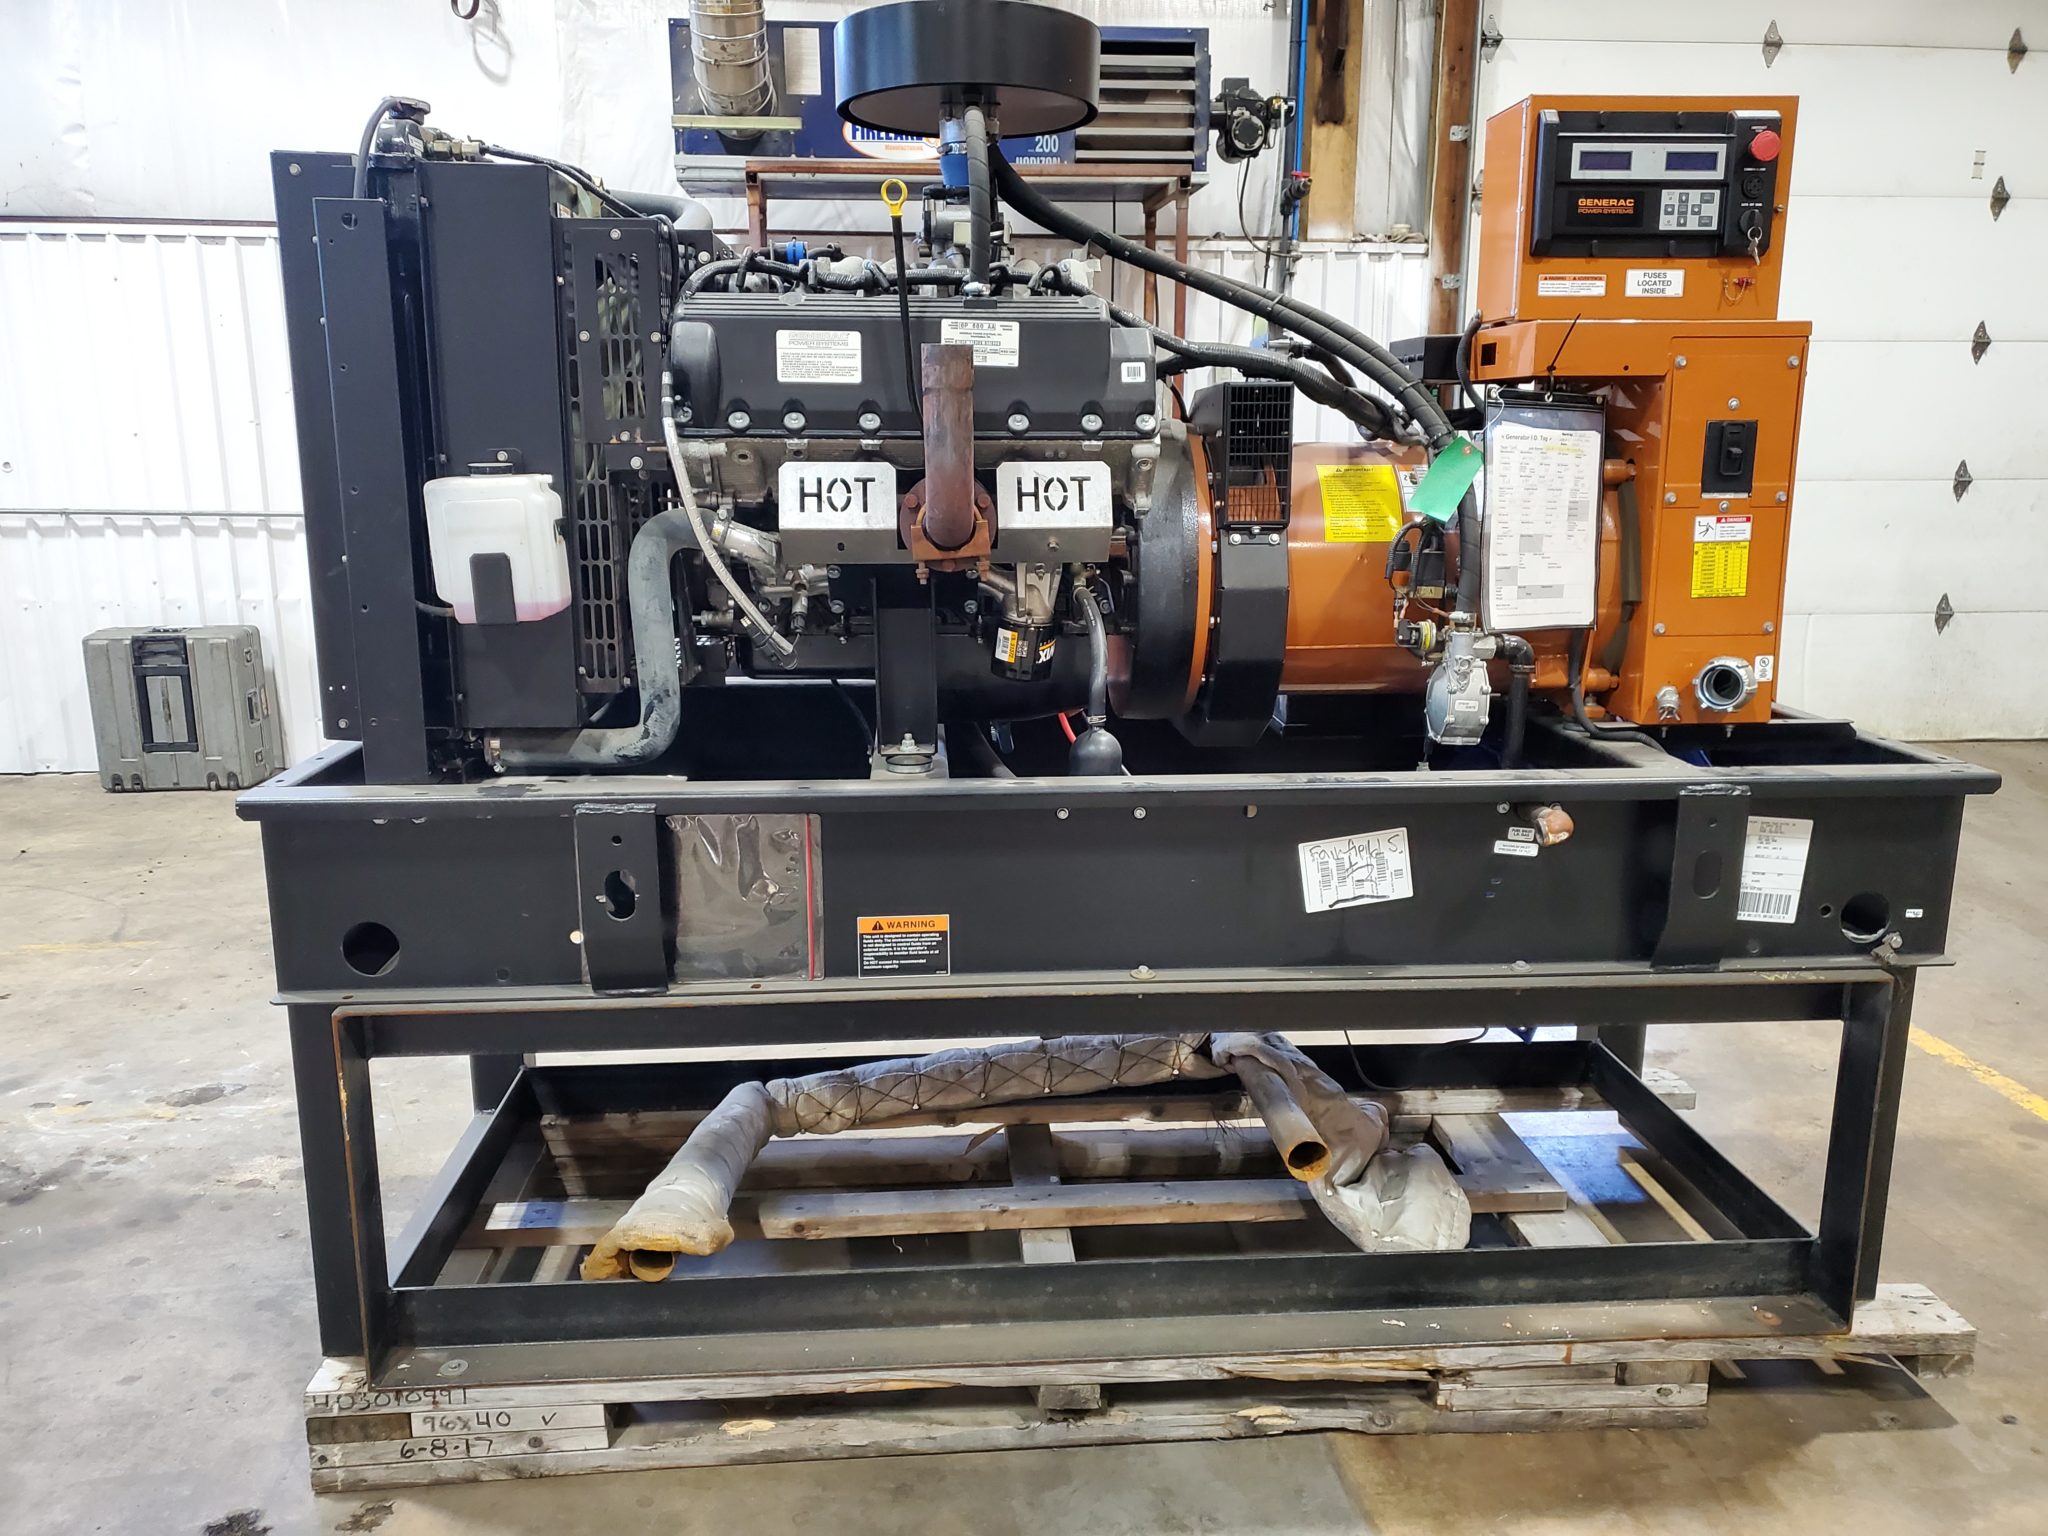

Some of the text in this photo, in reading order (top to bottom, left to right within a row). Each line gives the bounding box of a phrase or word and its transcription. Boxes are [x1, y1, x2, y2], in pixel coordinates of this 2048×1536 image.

[1035, 134, 1059, 153] 200
[1578, 198, 1634, 206] GENERAC
[799, 476, 876, 513] HOT
[1017, 476, 1091, 512] HOT
[887, 920, 936, 929] WARNING
